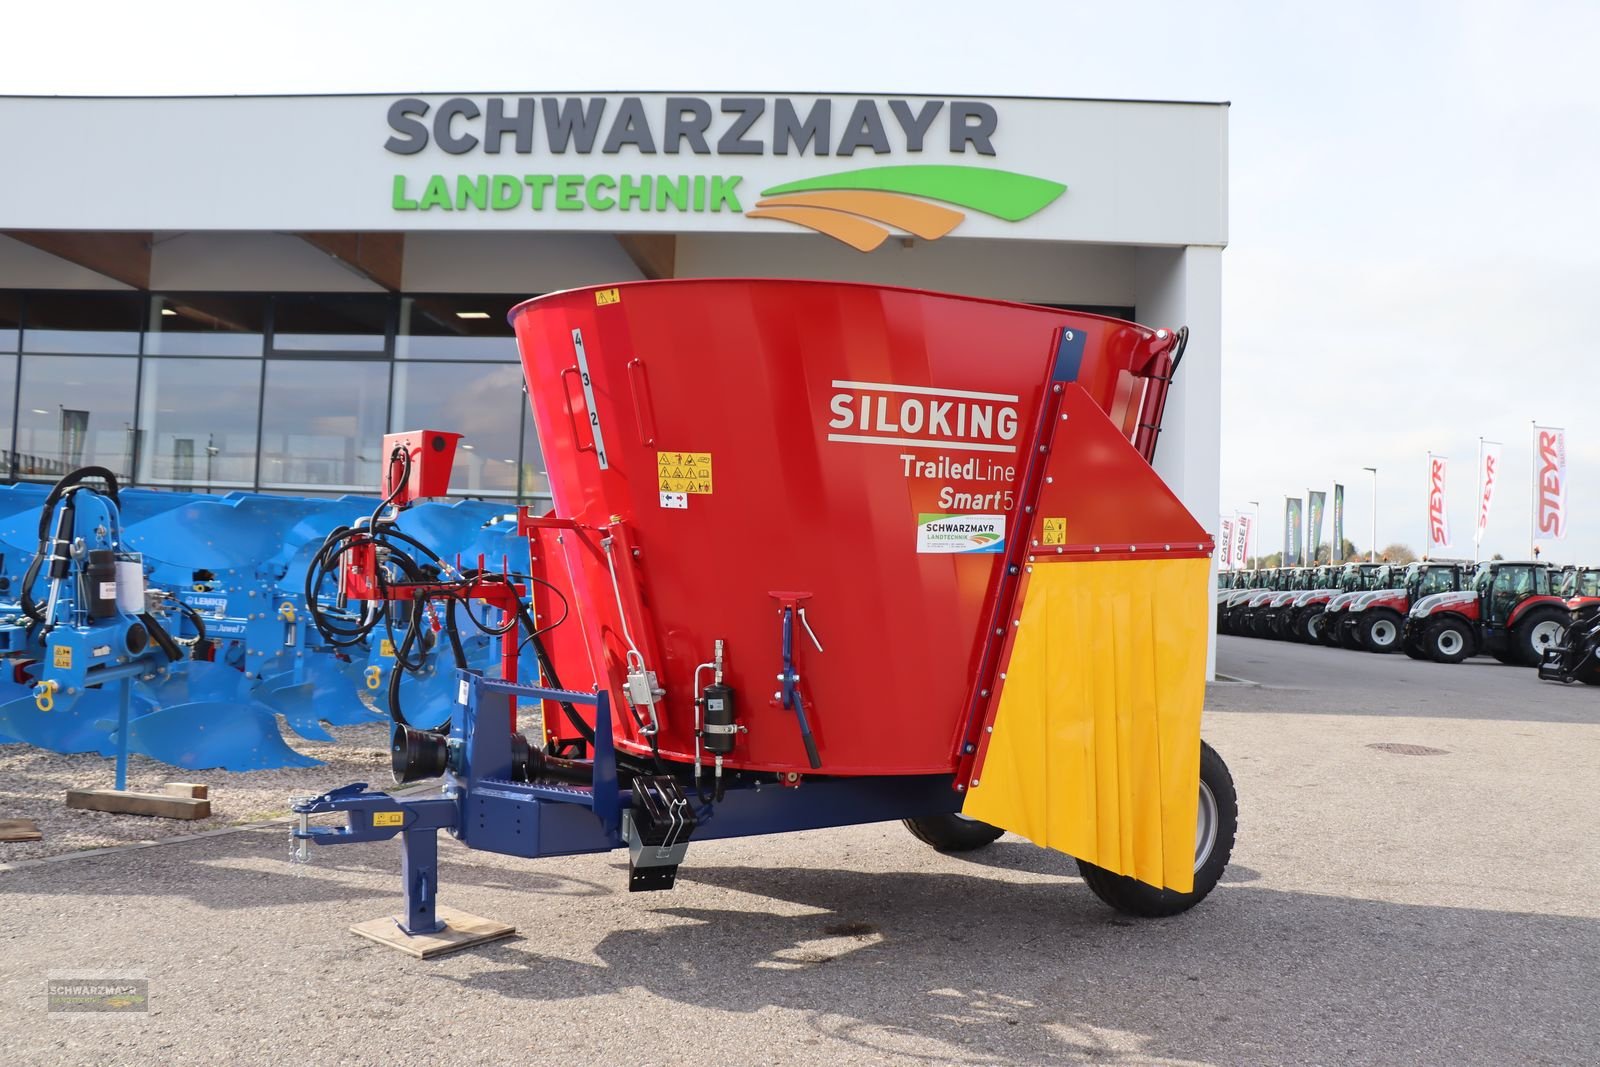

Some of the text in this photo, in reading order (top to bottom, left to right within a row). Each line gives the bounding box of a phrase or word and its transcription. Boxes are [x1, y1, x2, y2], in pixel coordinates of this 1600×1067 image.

[384, 97, 998, 156] SCHWARZMAYR
[392, 174, 743, 212] LANDTECHNIK
[575, 332, 582, 346] 4
[582, 372, 590, 387] 3
[590, 412, 598, 426] 2
[828, 393, 1018, 441] SILOKING
[599, 452, 606, 465] 1
[900, 454, 1015, 482] TrailedLine
[1539, 431, 1560, 537] STEYR
[1430, 459, 1447, 546] STEYR
[926, 524, 994, 533] SCHWARZMAYR
[1221, 531, 1229, 562] CASE
[1237, 528, 1246, 561] CASE
